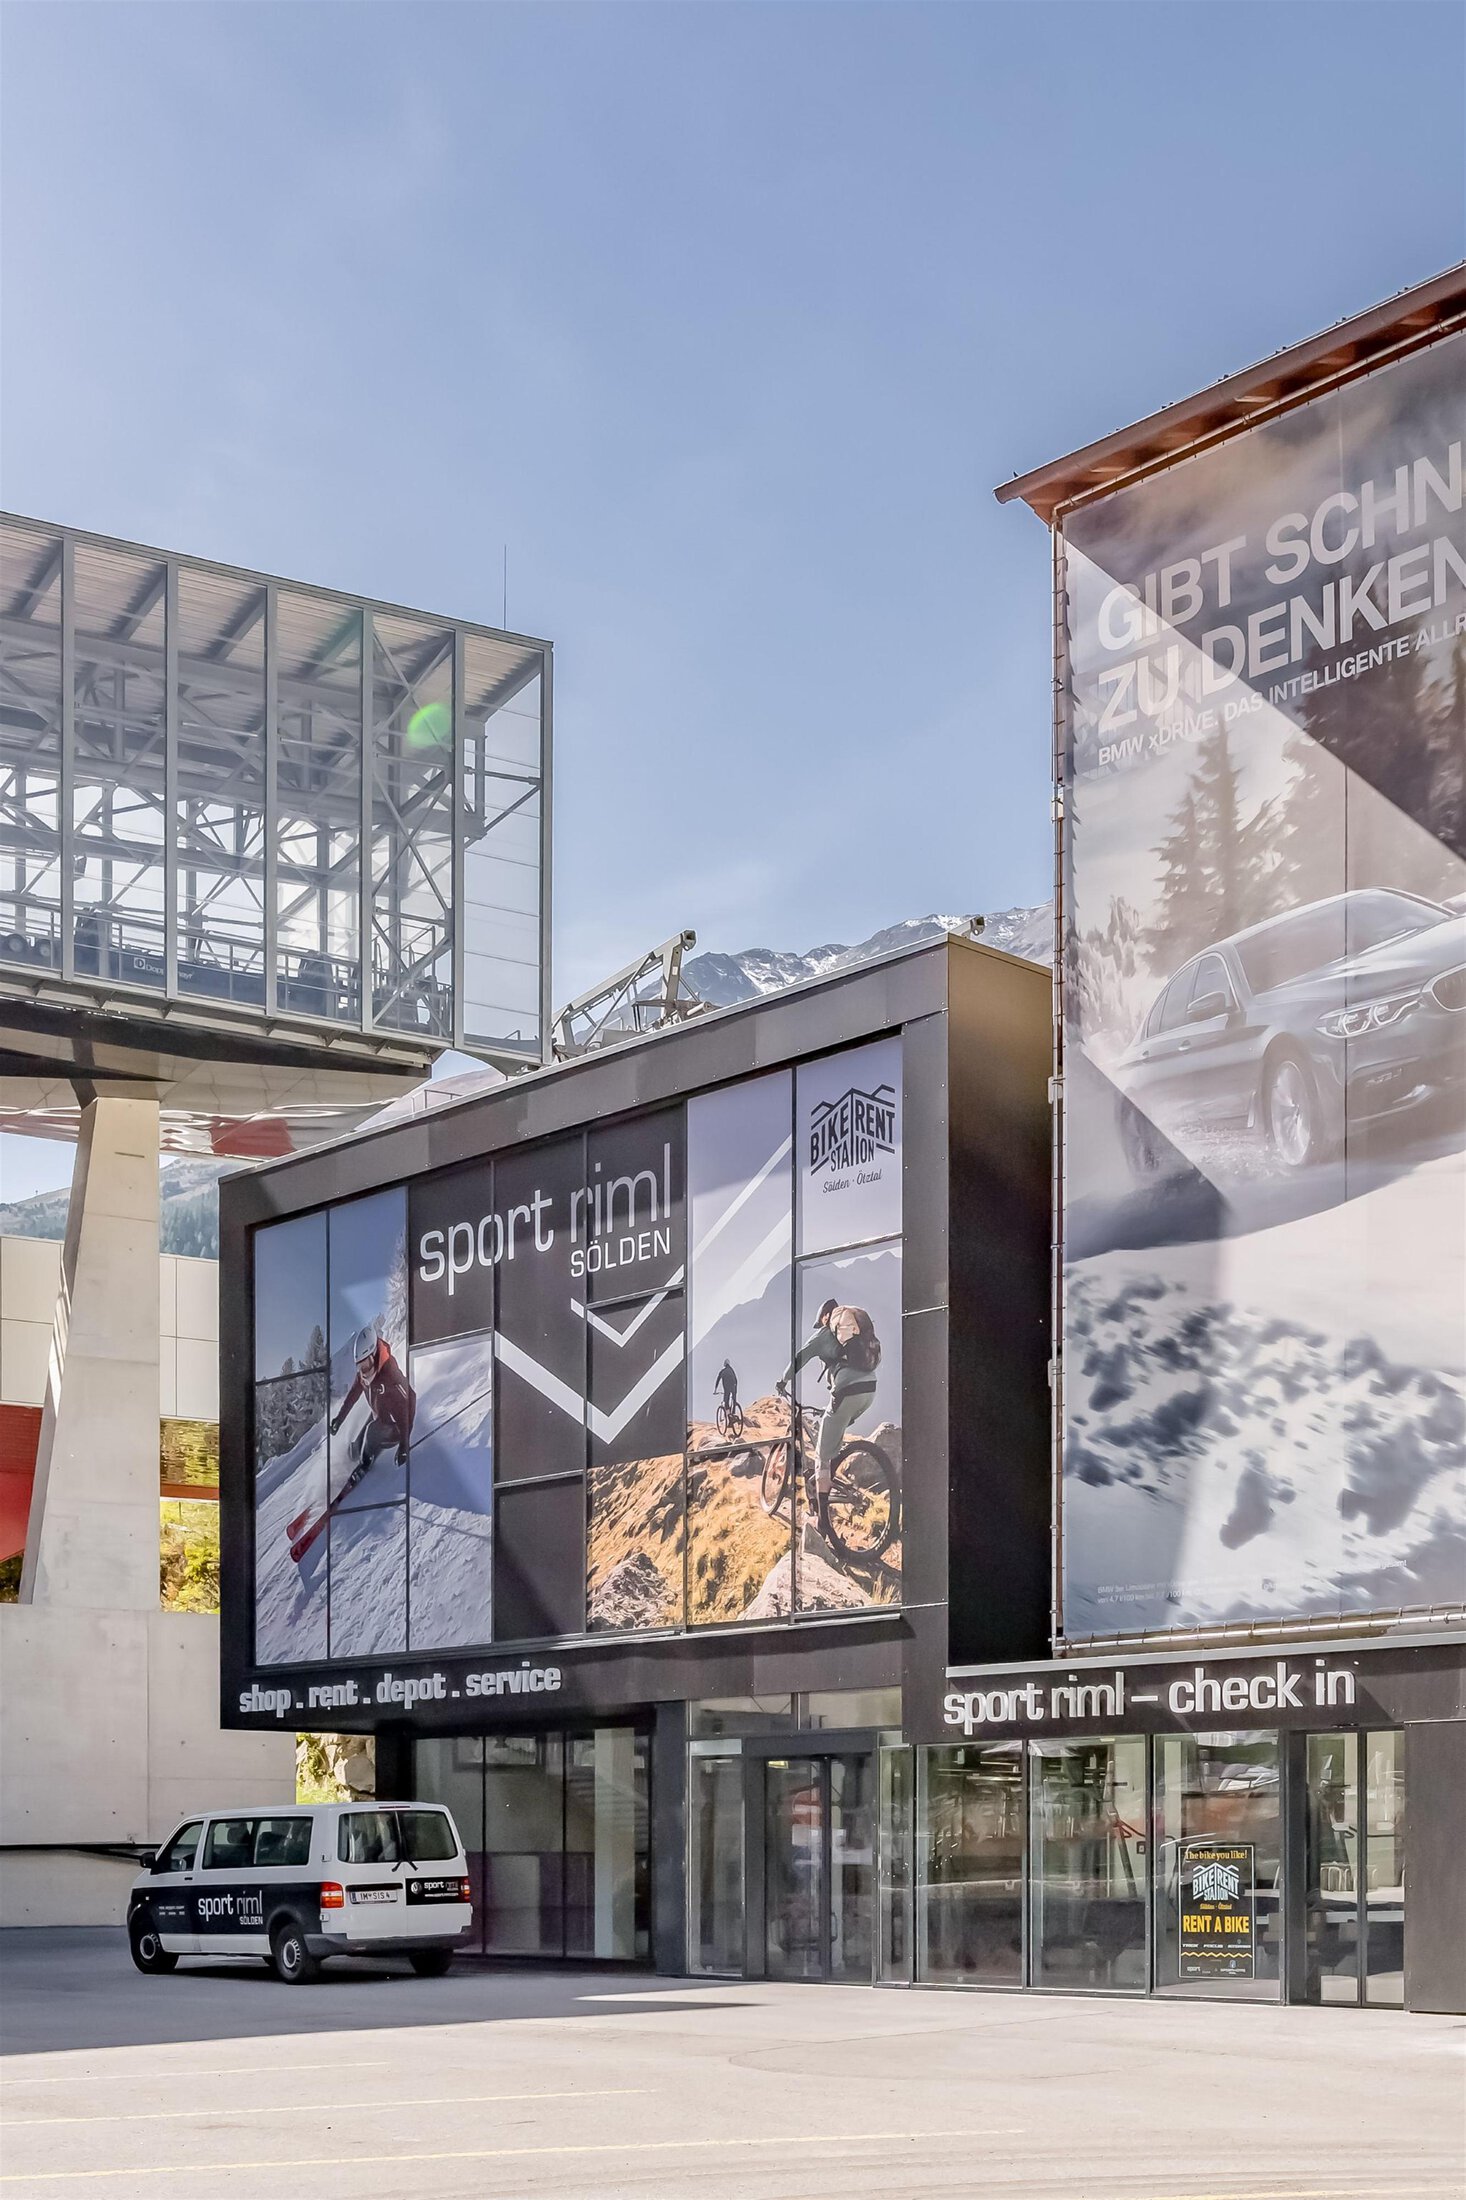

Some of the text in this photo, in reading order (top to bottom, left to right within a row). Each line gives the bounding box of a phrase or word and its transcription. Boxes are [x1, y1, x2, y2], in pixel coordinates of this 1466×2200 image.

[1099, 440, 1463, 651] GIBT SCHN
[1098, 535, 1466, 734] ZU DENKEN
[1099, 734, 1144, 766] BMW
[1224, 691, 1263, 723] DAS
[1268, 634, 1410, 703] INTELLIGENTE
[810, 1098, 895, 1167] BIKE RENT
[822, 1178, 850, 1194] Sölden
[419, 1142, 671, 1296] sport riml
[570, 1226, 671, 1278] SÖLDEN
[239, 1684, 292, 1718] shop
[308, 1680, 359, 1708] rent
[376, 1673, 447, 1710] depot
[465, 1661, 562, 1697] service
[943, 1683, 1045, 1736] sport
[1051, 1671, 1125, 1720] riml
[1168, 1661, 1304, 1715] check
[1315, 1658, 1356, 1706] in
[1193, 1867, 1239, 1896] BIKE RENT
[1200, 1850, 1215, 1859] bike
[1216, 1852, 1230, 1861] you
[198, 1890, 263, 1922] sport riml
[424, 1881, 444, 1891] sport
[1183, 1915, 1249, 1933] RENT A BIKE
